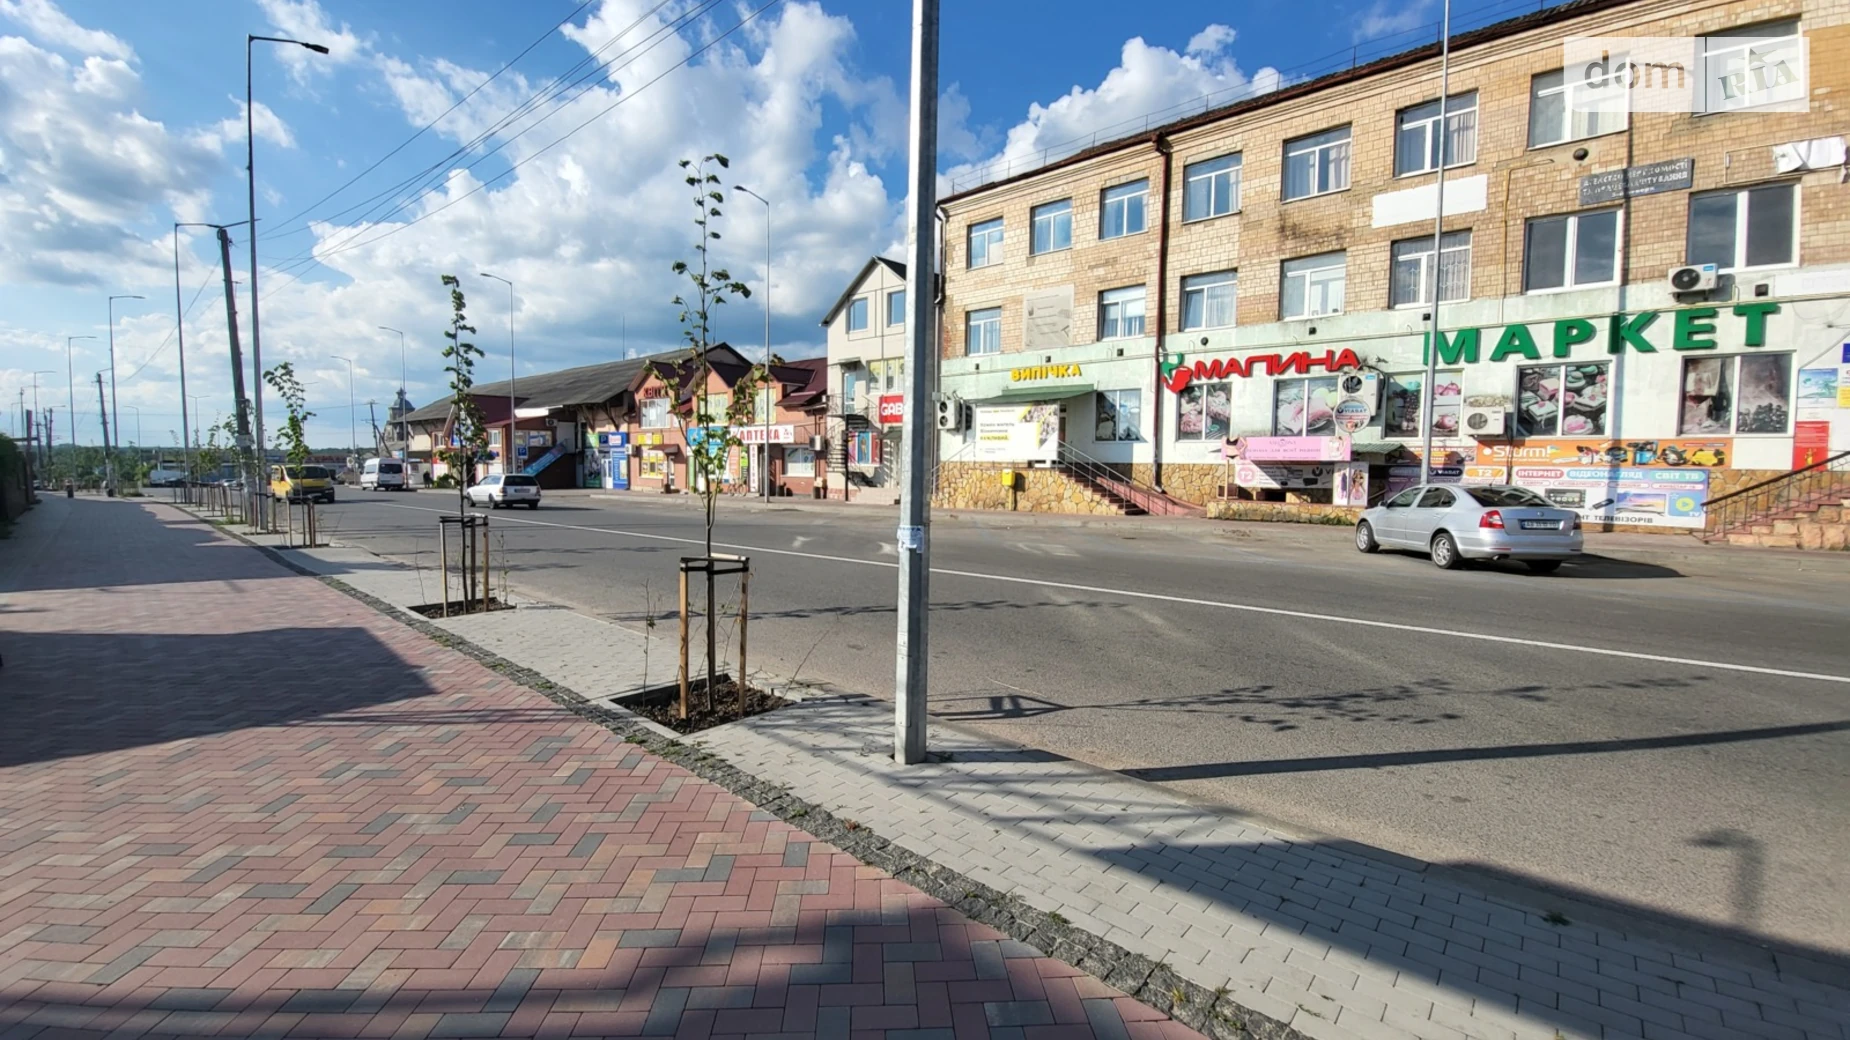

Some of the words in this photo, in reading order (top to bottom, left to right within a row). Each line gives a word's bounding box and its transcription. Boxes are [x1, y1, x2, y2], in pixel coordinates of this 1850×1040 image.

[1423, 302, 1780, 365] МАРКЕТ
[1194, 348, 1362, 380] МАЛИНА
[1011, 363, 1082, 382] ВИПІЧКА
[740, 429, 780, 440] АПТЕКА
[1240, 471, 1253, 479] T2
[1476, 469, 1492, 477] T2
[1655, 471, 1680, 480] СВІТ
[1685, 472, 1699, 480] ТВ
[1594, 515, 1654, 523] ТЕЛЕВІЗОРІВ
